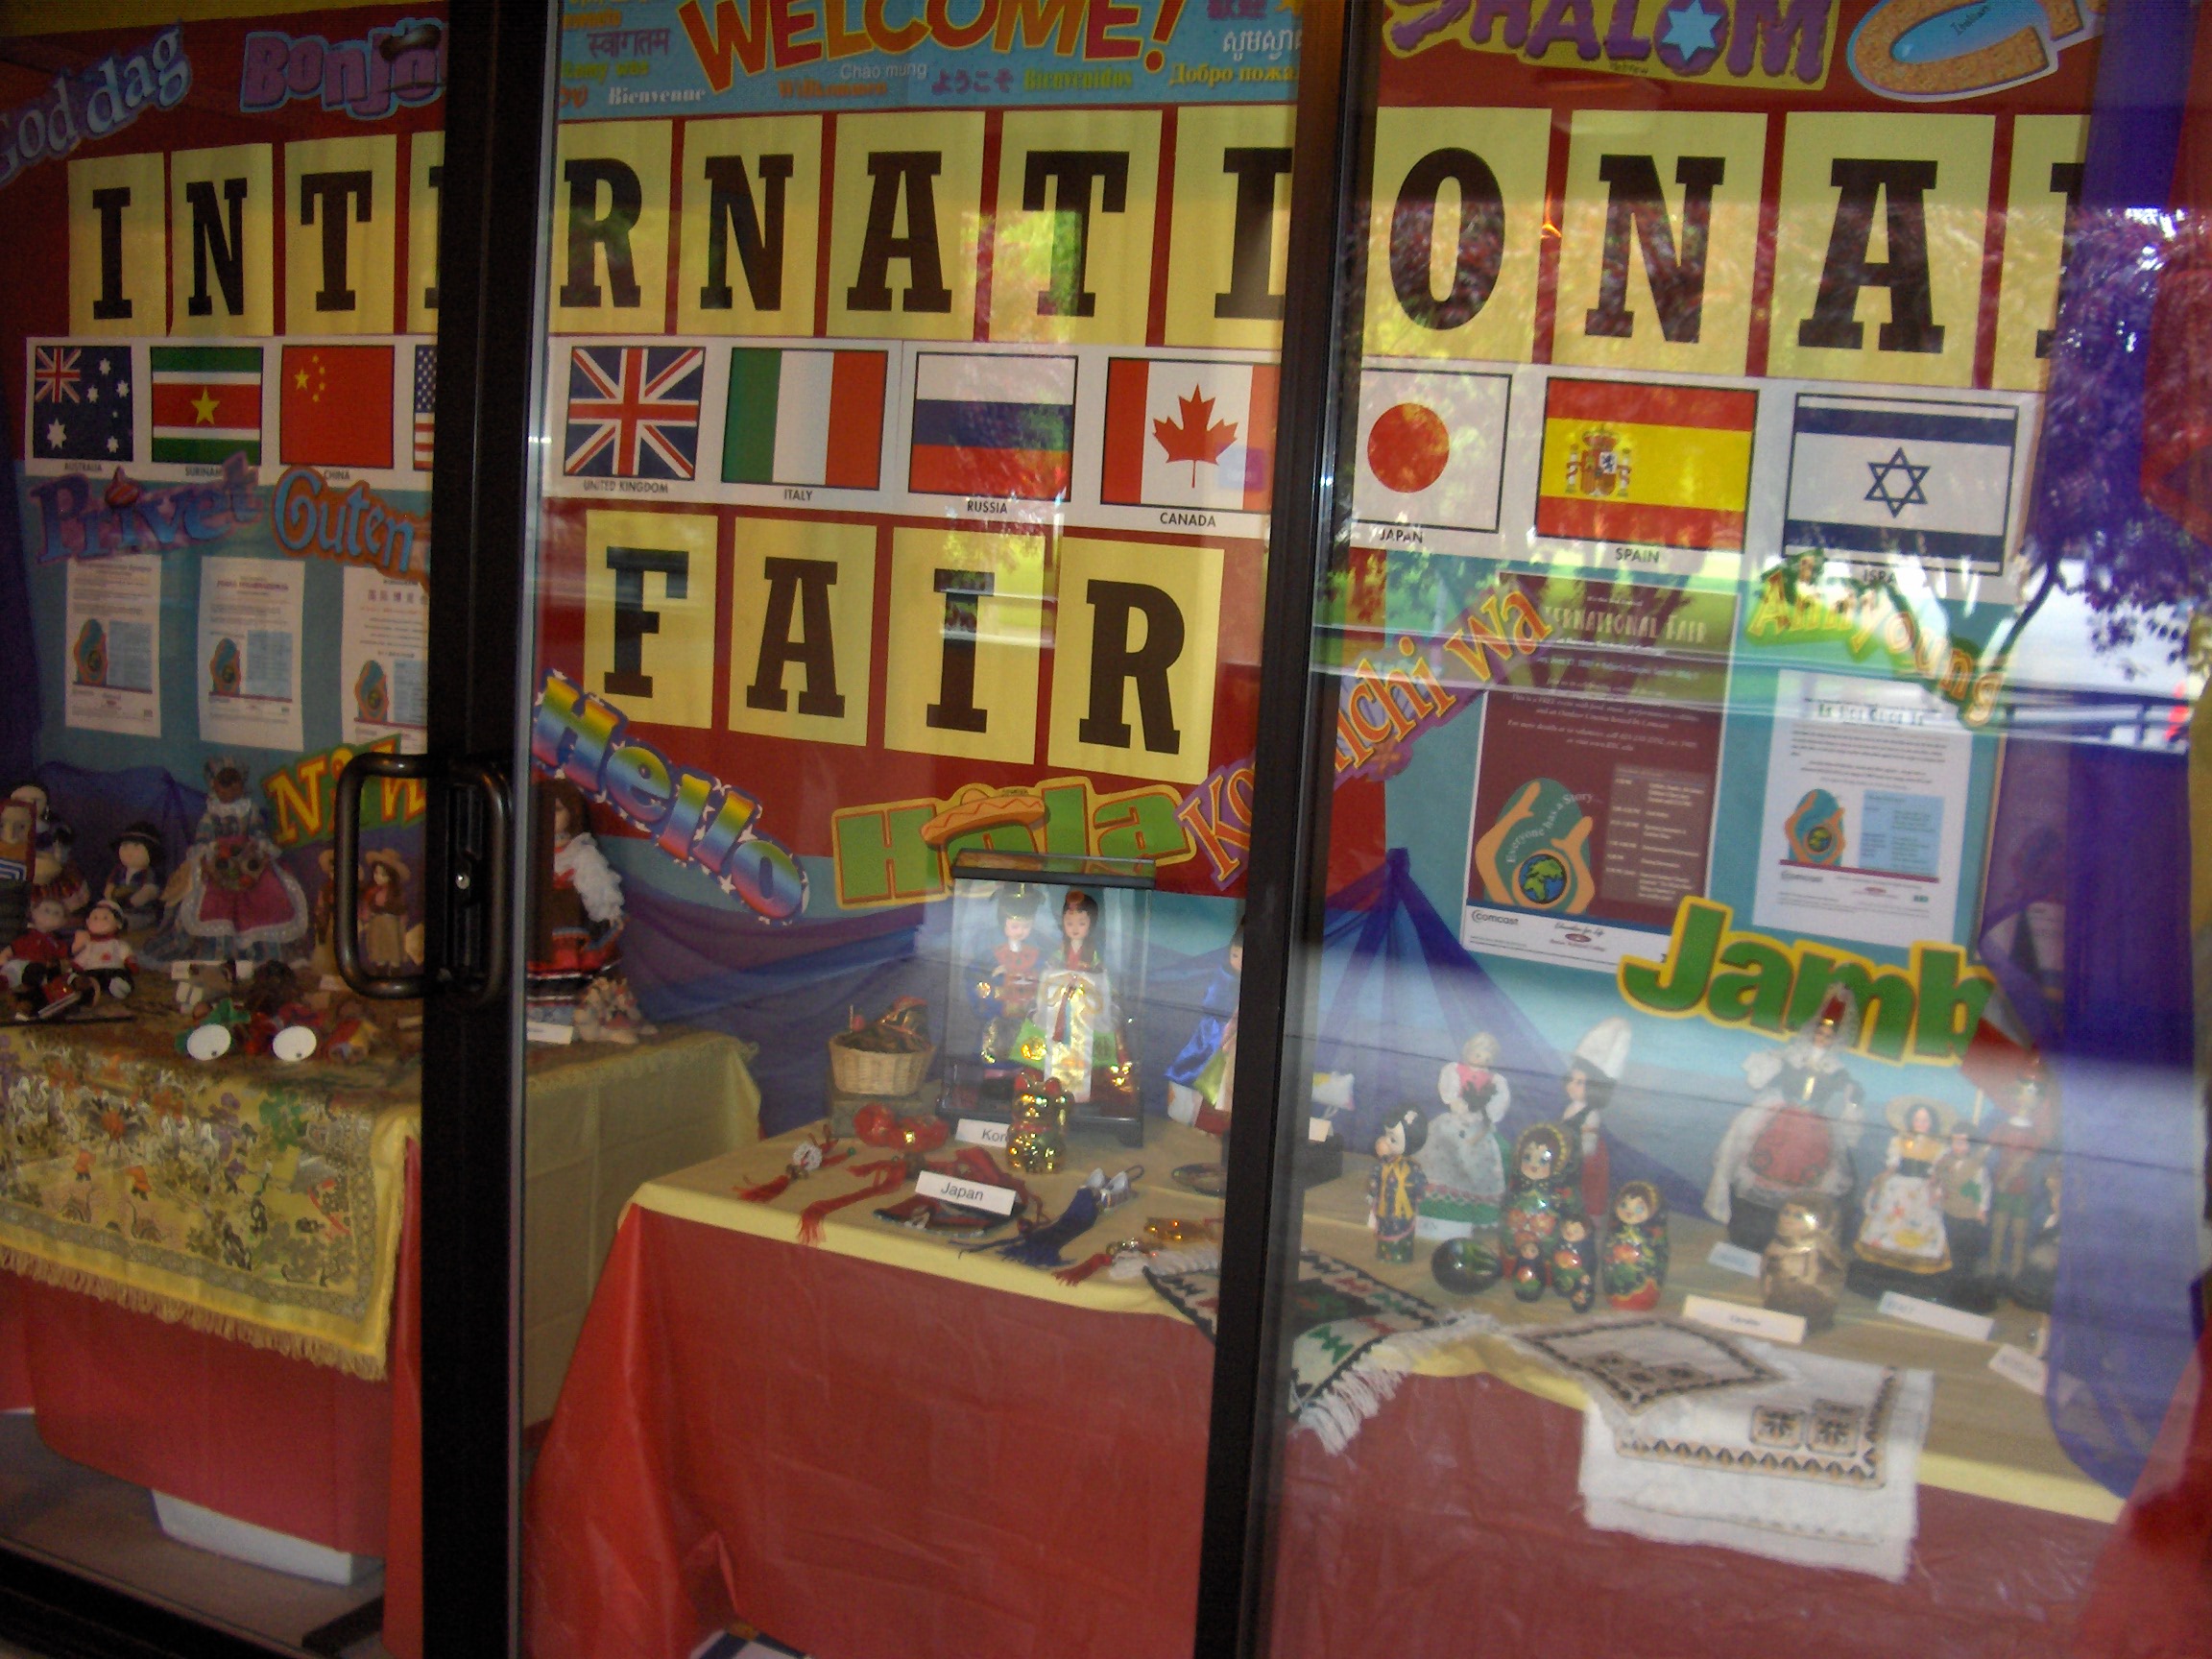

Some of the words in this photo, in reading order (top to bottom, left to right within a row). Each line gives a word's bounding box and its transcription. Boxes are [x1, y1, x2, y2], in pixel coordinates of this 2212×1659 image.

[675, 0, 1187, 94] WELCOME!
[86, 27, 188, 135] dag
[1168, 62, 1233, 87] Добро
[608, 85, 706, 106] Bienvenue
[184, 467, 224, 478] SURINAM
[323, 469, 350, 481] CHINA
[584, 479, 615, 492] UNITED
[619, 481, 669, 495] KINGDOM
[783, 488, 814, 501] ITALY
[967, 499, 1008, 515] RUSSIA
[273, 471, 414, 573] Guten
[1159, 513, 1216, 529] CANADA
[1380, 528, 1425, 543] JAPAN
[1615, 546, 1661, 565] SPAIN
[604, 546, 1186, 755] FAIR
[534, 672, 805, 921] Hello
[838, 781, 1190, 905] Hola
[1623, 901, 1997, 1062] Jamb
[981, 1128, 1008, 1142] Kor
[941, 1182, 984, 1202] Japan
